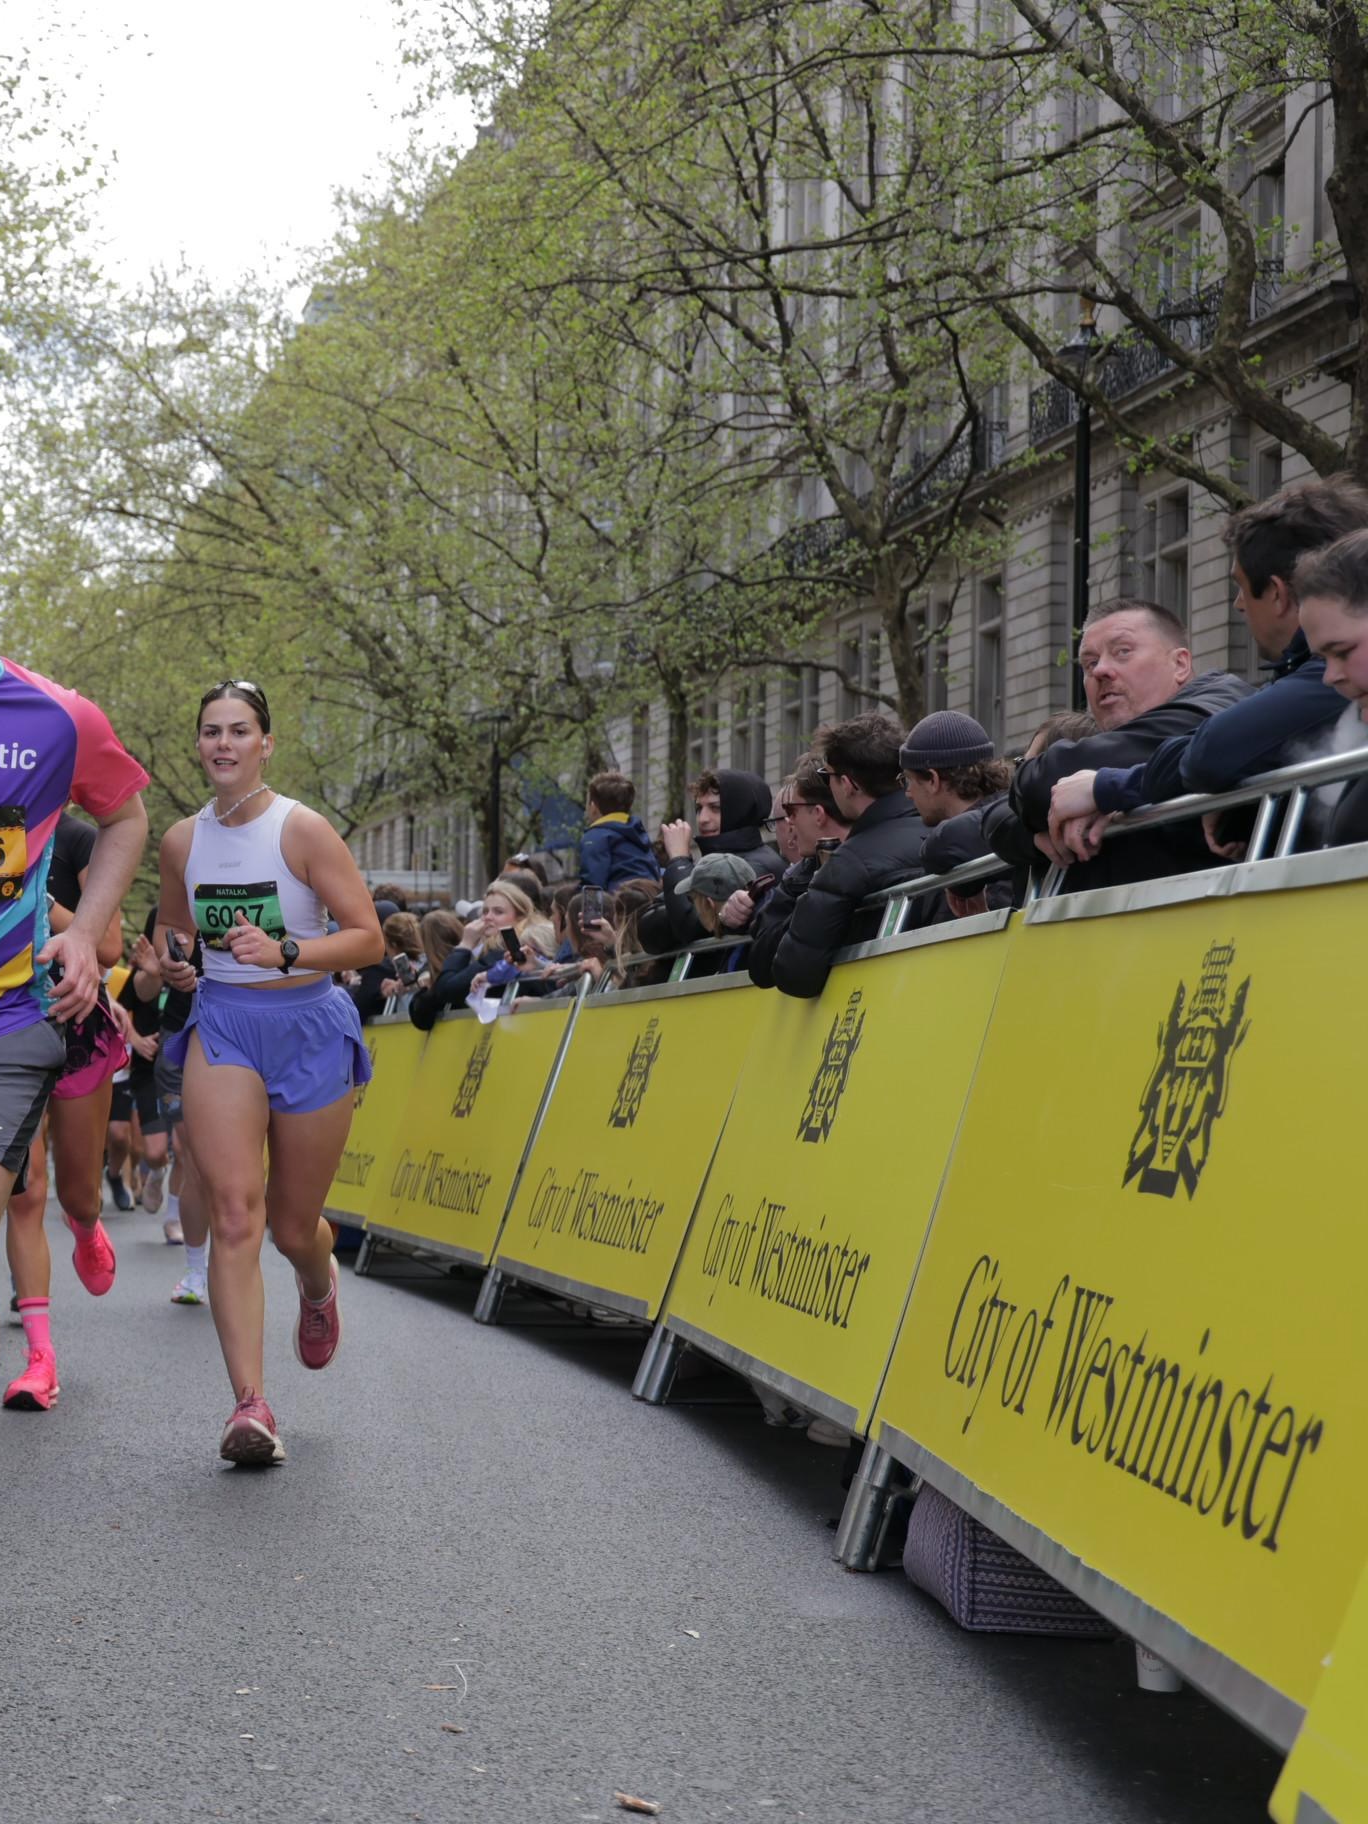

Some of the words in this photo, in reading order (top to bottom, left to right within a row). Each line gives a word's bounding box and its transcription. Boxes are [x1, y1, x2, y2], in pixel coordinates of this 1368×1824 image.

[216, 888, 248, 896] NATALKA
[423, 1152, 492, 1215] Westminster
[528, 1167, 562, 1249] City
[551, 1168, 585, 1233] of
[569, 1172, 665, 1254] Westminster
[703, 1193, 740, 1307] City
[728, 1196, 767, 1287] of
[749, 1203, 871, 1329] Westminster
[944, 1254, 1018, 1435] City
[1000, 1274, 1070, 1416] of
[1044, 1286, 1324, 1553] Westminster
